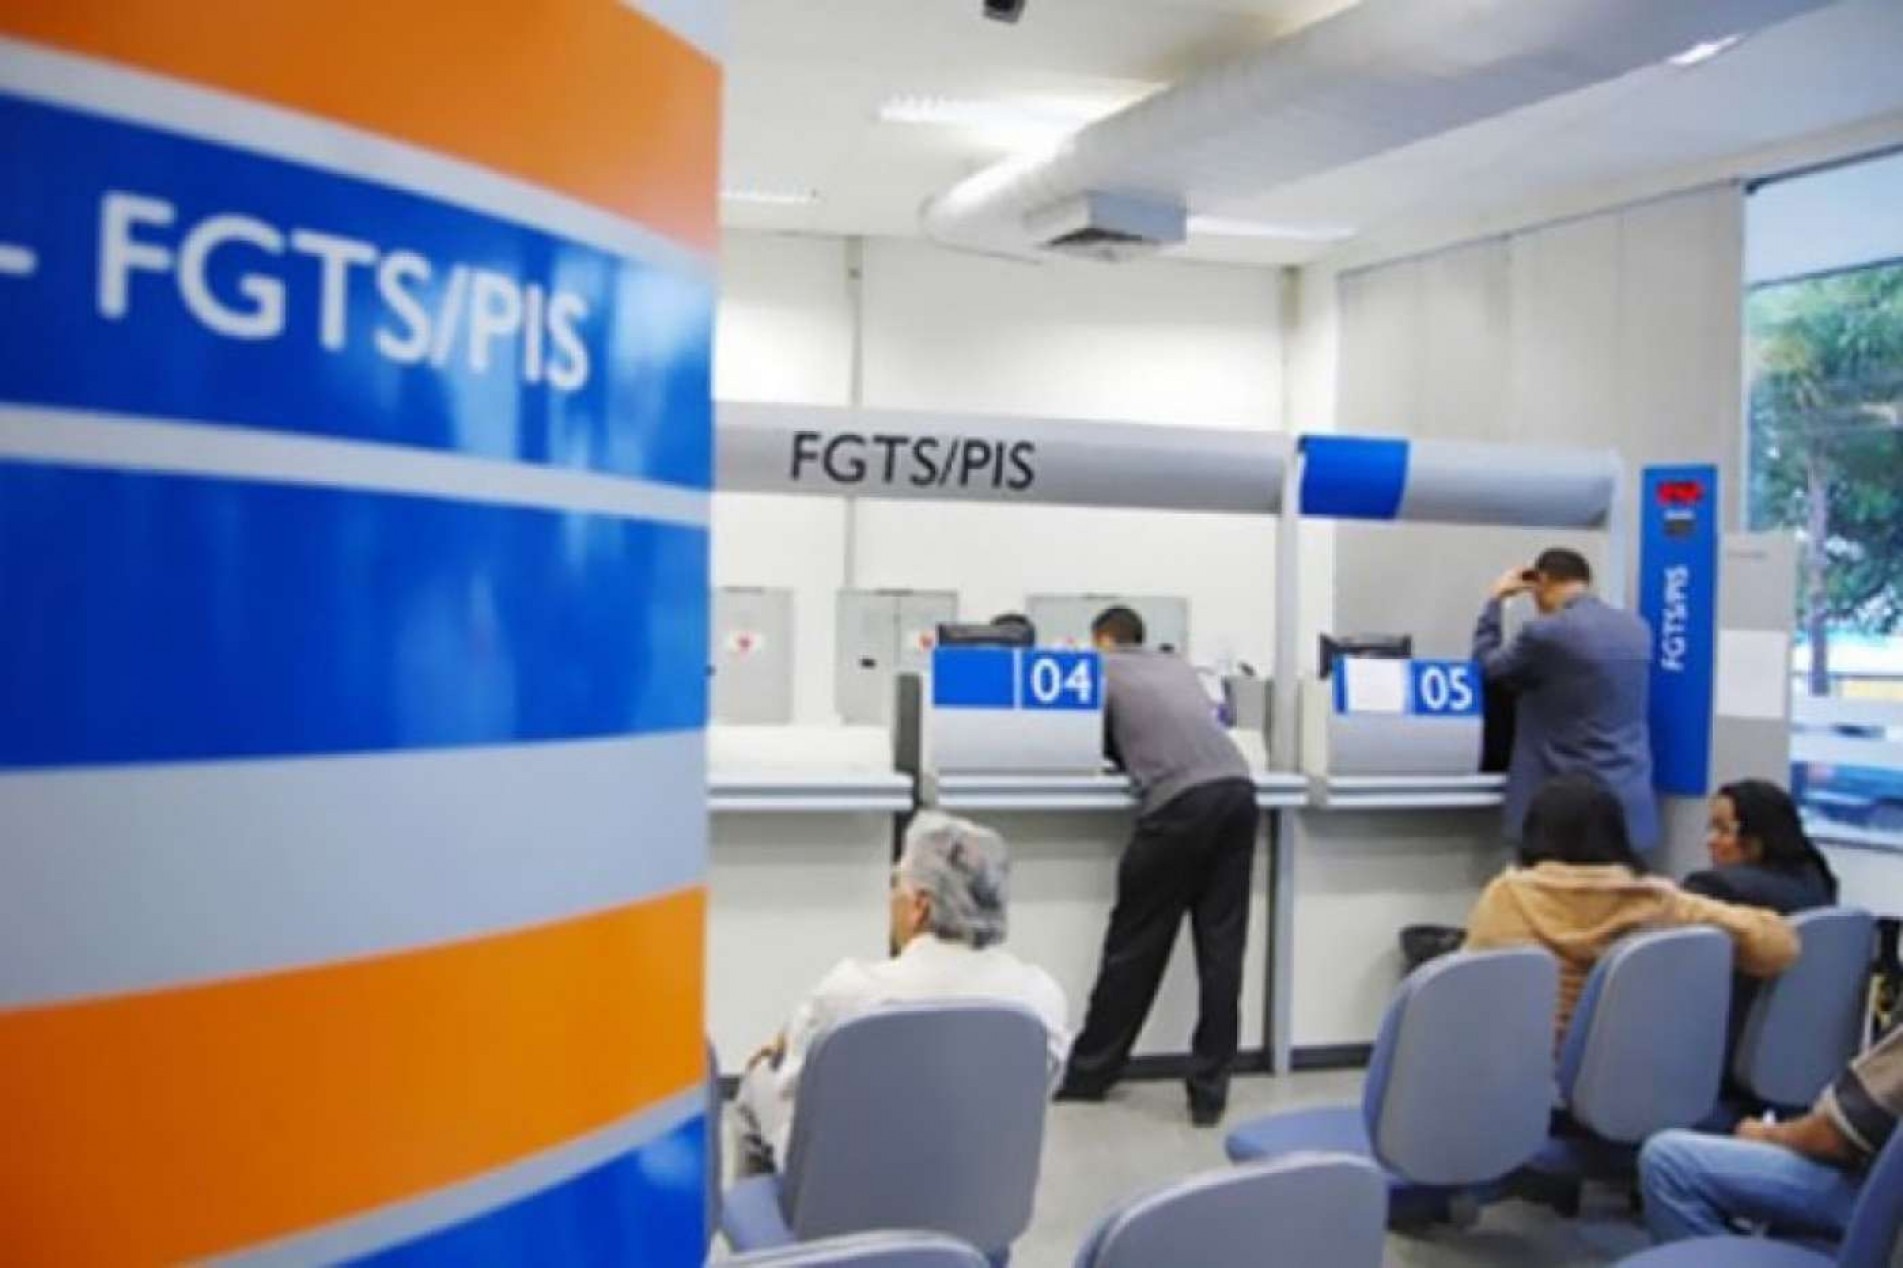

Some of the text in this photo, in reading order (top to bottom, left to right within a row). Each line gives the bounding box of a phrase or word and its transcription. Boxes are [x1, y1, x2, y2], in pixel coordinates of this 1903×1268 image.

[96, 190, 590, 391] FGTS/PIS
[790, 431, 1036, 491] FGTS/PIS
[1031, 657, 1093, 704] 04
[1420, 664, 1473, 711] 05
